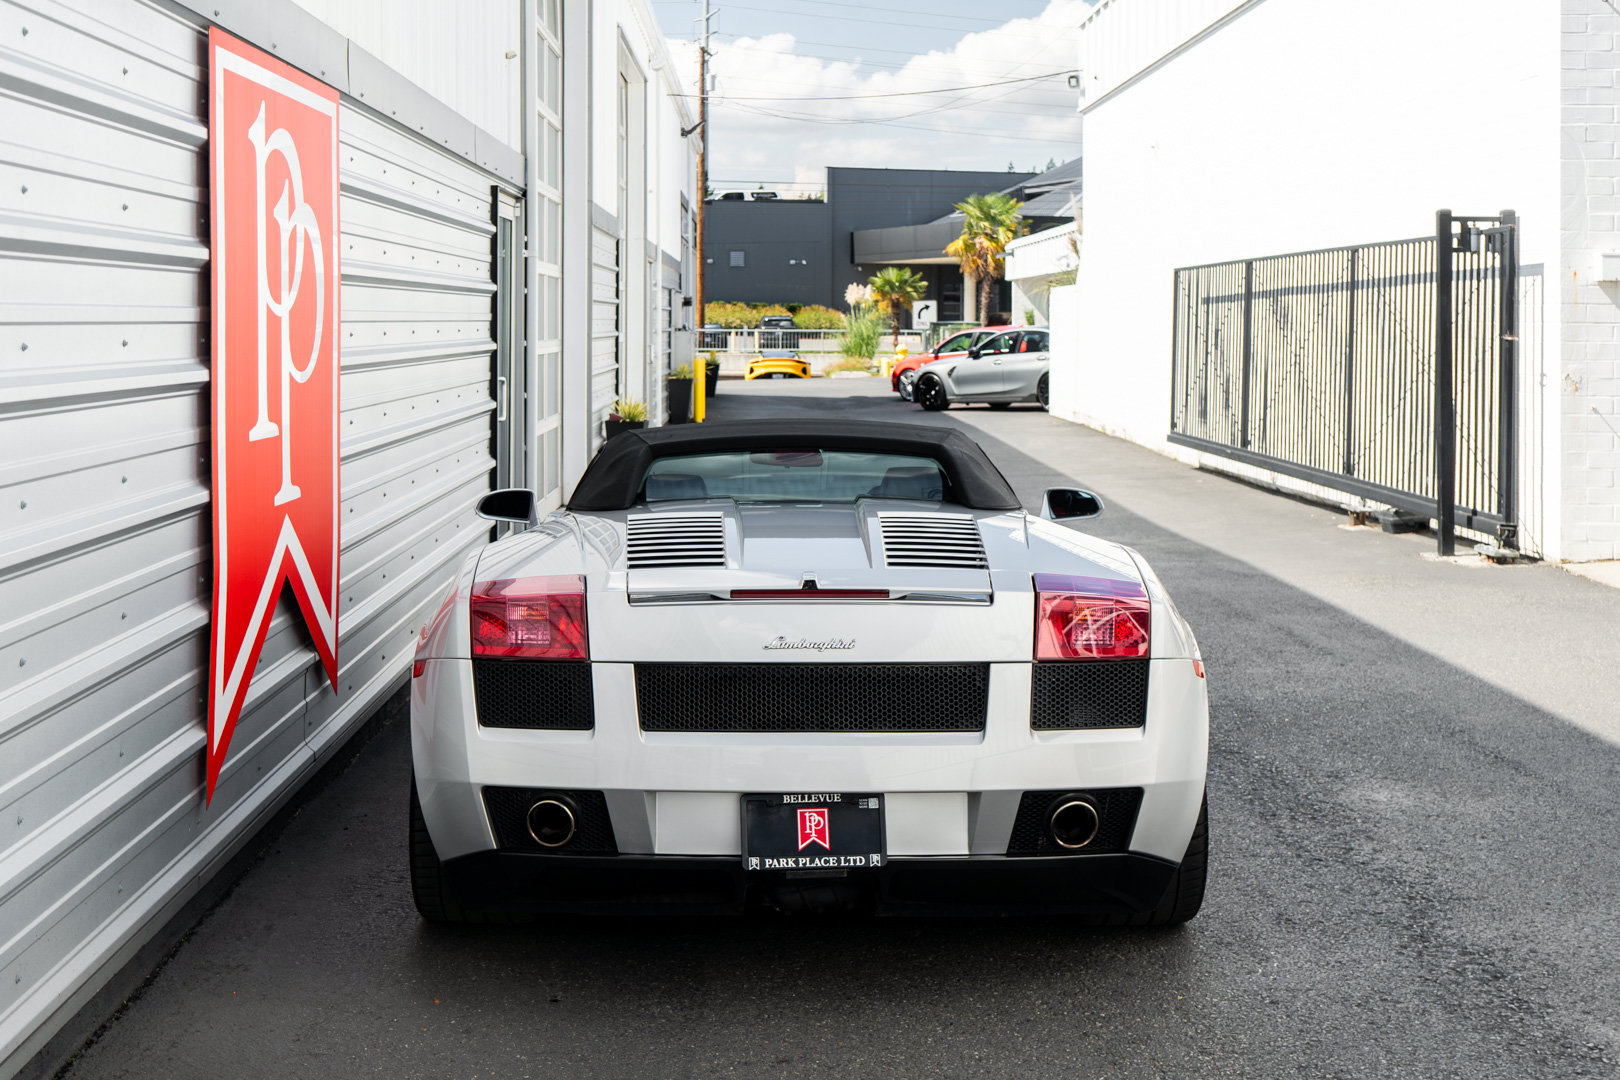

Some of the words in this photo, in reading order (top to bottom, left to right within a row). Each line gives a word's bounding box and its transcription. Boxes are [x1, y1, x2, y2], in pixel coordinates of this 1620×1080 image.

[763, 636, 856, 652] Lamborghini
[783, 793, 842, 803] BELLEVUE
[765, 858, 796, 869] PARK
[798, 857, 838, 868] PLACE
[840, 856, 866, 866] LTD
